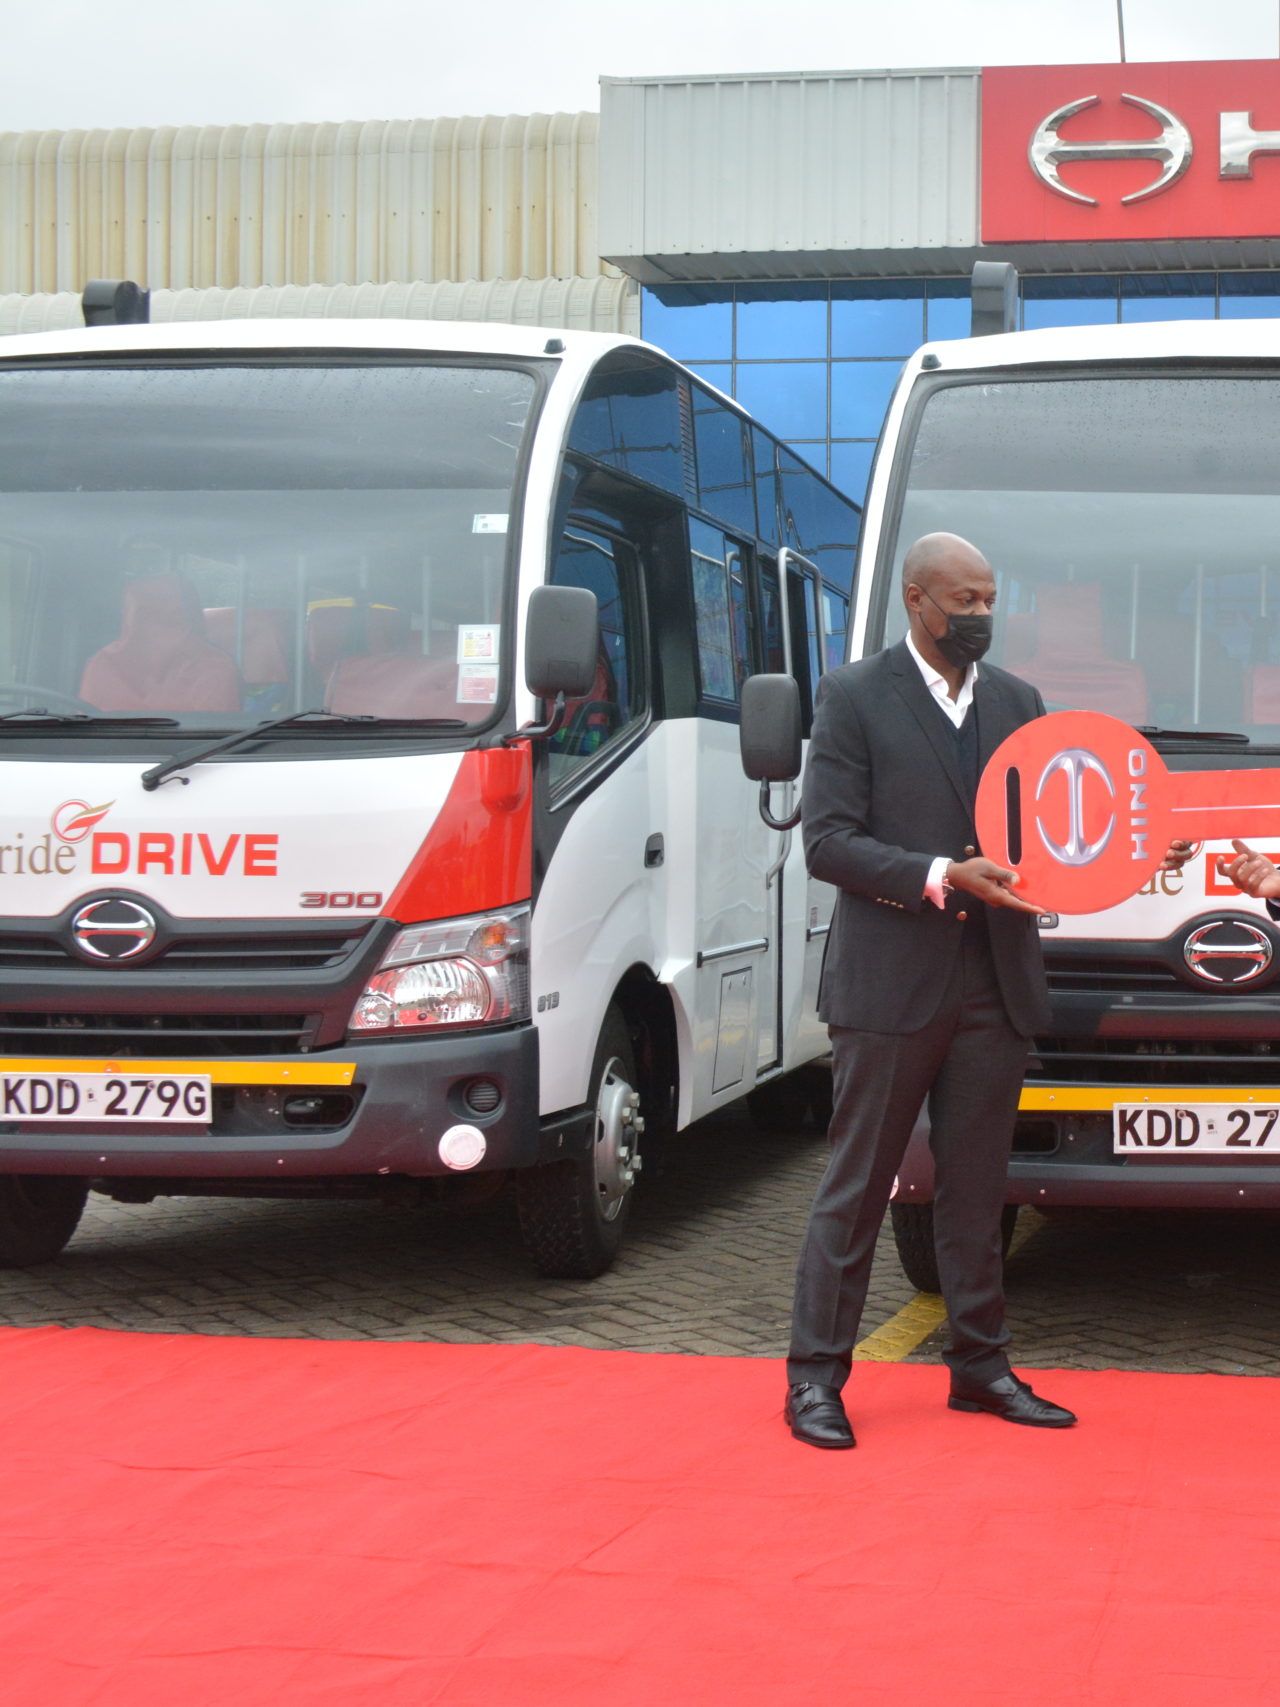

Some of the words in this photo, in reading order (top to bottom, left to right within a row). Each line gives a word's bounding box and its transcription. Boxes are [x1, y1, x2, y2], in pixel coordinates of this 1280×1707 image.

[1127, 748, 1149, 861] HINO
[90, 832, 279, 876] DRIVE
[300, 891, 383, 910] 300
[2, 1078, 80, 1116] KDD
[104, 1079, 206, 1117] 279G
[1118, 1109, 1201, 1148] KDD
